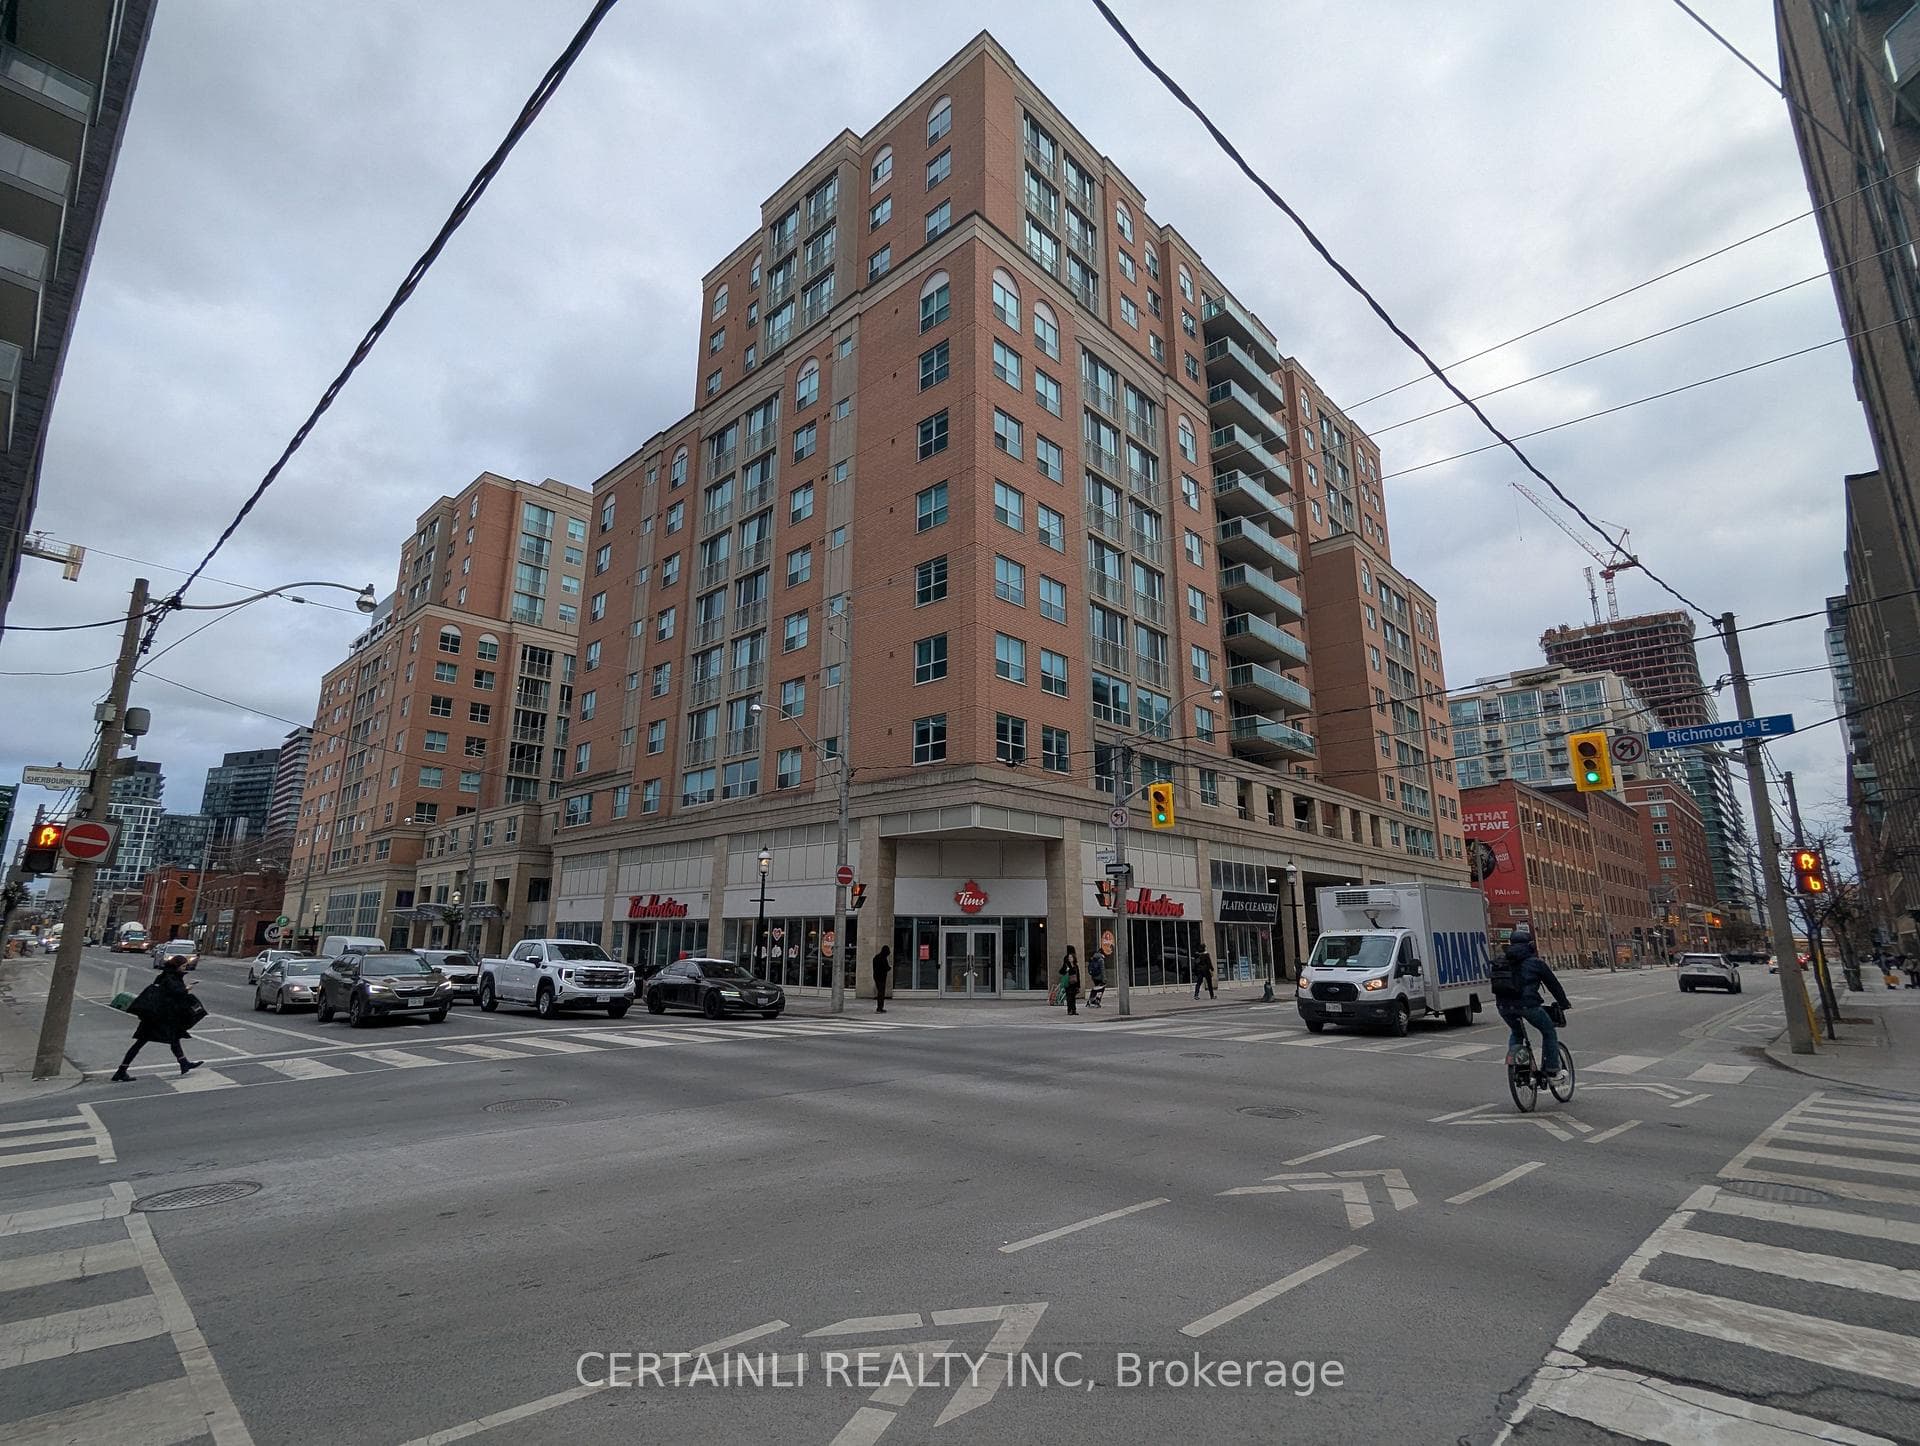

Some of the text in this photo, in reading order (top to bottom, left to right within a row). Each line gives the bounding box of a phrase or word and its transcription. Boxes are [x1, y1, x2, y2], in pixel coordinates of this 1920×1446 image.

[1667, 719, 1771, 743] Richmond St E
[26, 776, 75, 786] SHERBOURNE
[1462, 811, 1508, 822] H THAT
[1480, 820, 1510, 831] FAVE
[628, 894, 688, 918] Tim Hortons
[958, 891, 985, 906] Tims
[1137, 887, 1184, 917] Hortons
[1221, 900, 1276, 912] PLATIS CLEANERS
[1433, 931, 1491, 985] DIANA'S
